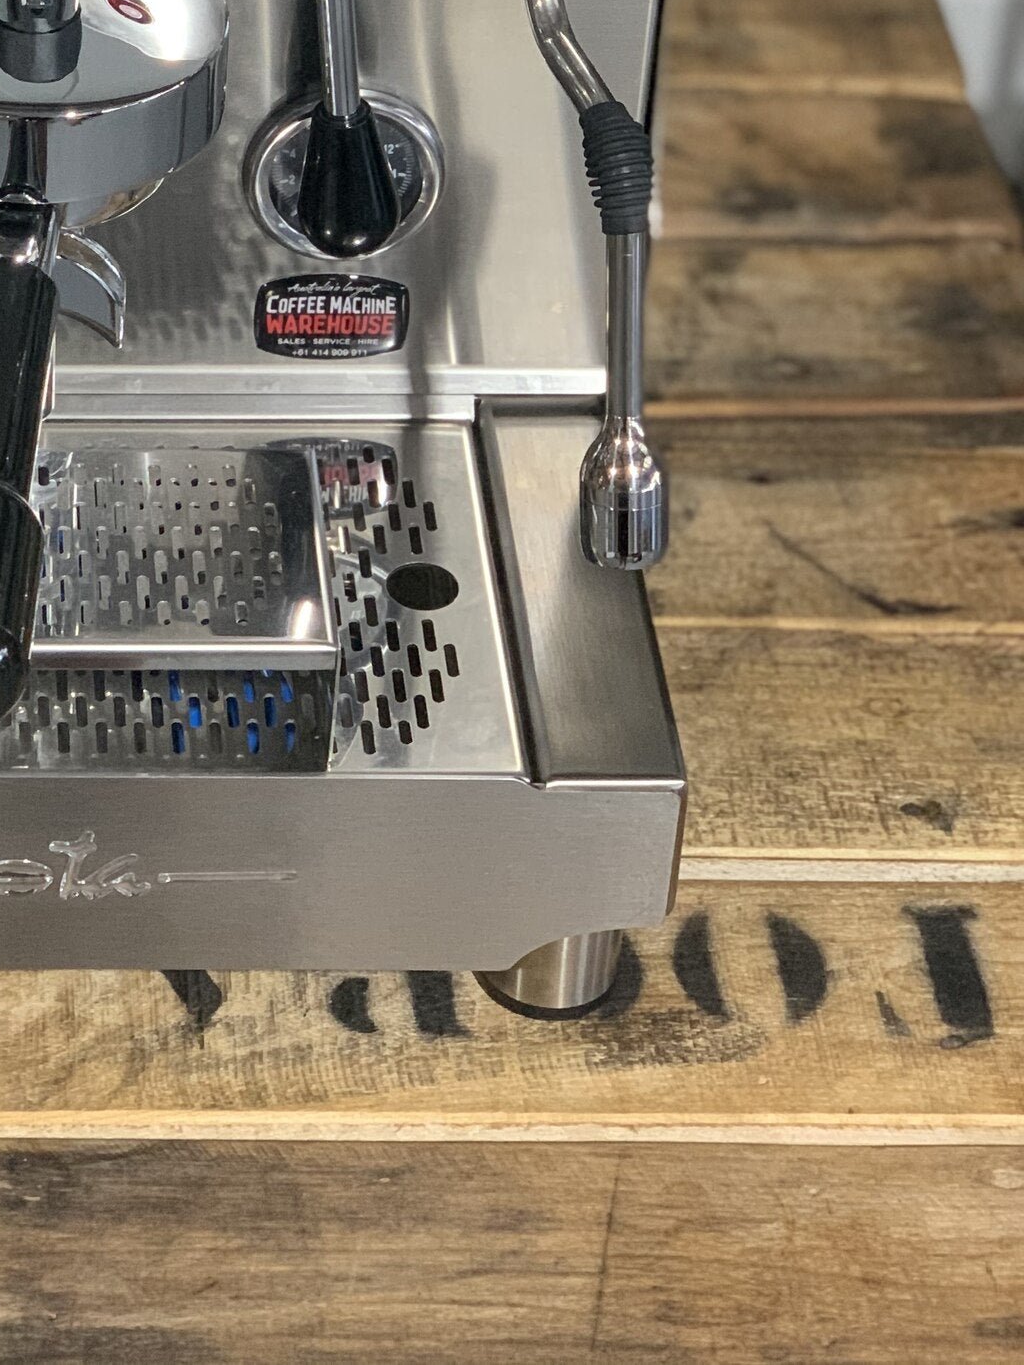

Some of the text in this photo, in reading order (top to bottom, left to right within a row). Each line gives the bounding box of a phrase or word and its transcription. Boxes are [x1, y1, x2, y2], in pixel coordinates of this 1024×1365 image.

[288, 174, 296, 185] 2
[266, 295, 397, 315] COFFEE MACHINE
[266, 314, 395, 335] WAREHOUSE
